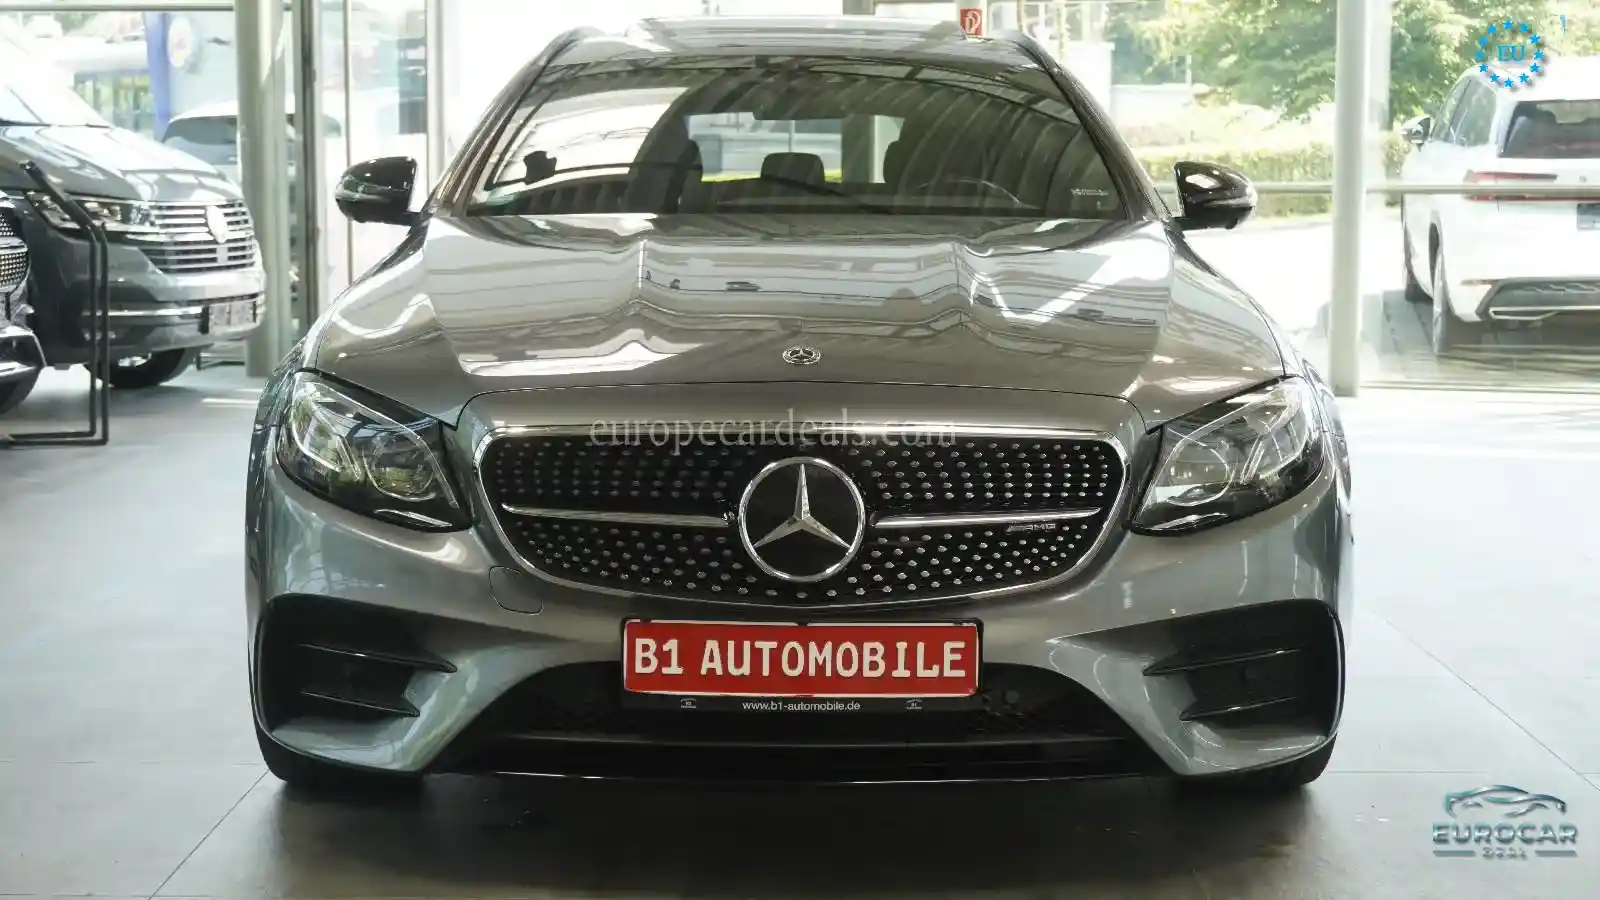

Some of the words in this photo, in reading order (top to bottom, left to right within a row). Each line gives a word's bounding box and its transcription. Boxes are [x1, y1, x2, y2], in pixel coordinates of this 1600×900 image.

[634, 638, 684, 675] B1
[700, 639, 966, 678] AUTOMOBILE
[742, 700, 861, 712] www.b1-automobile.de
